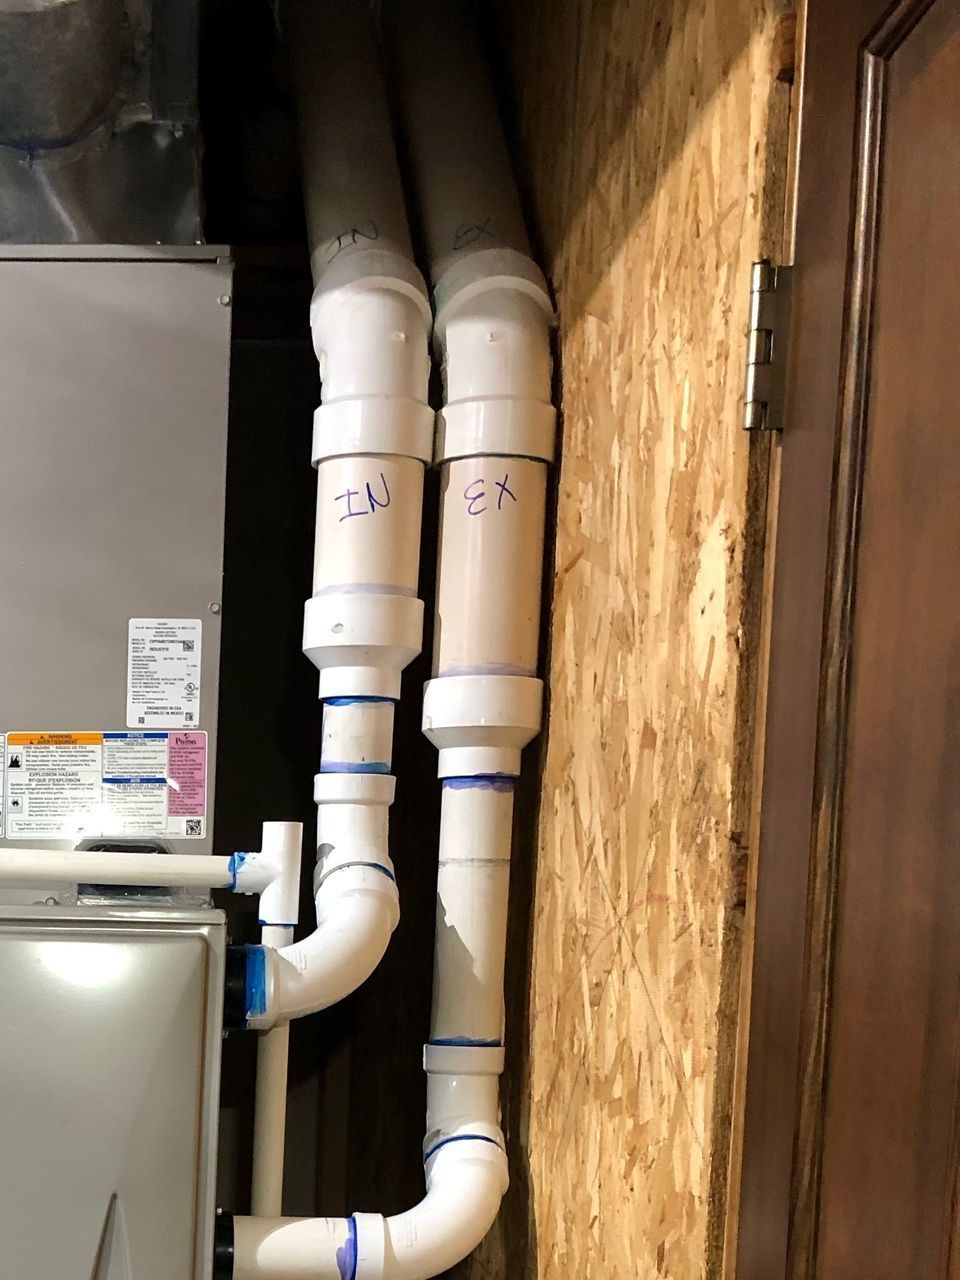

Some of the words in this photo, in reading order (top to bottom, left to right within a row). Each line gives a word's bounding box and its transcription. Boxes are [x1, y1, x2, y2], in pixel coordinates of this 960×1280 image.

[325, 219, 380, 264] IN
[334, 472, 391, 522] IN
[464, 473, 518, 517] EX
